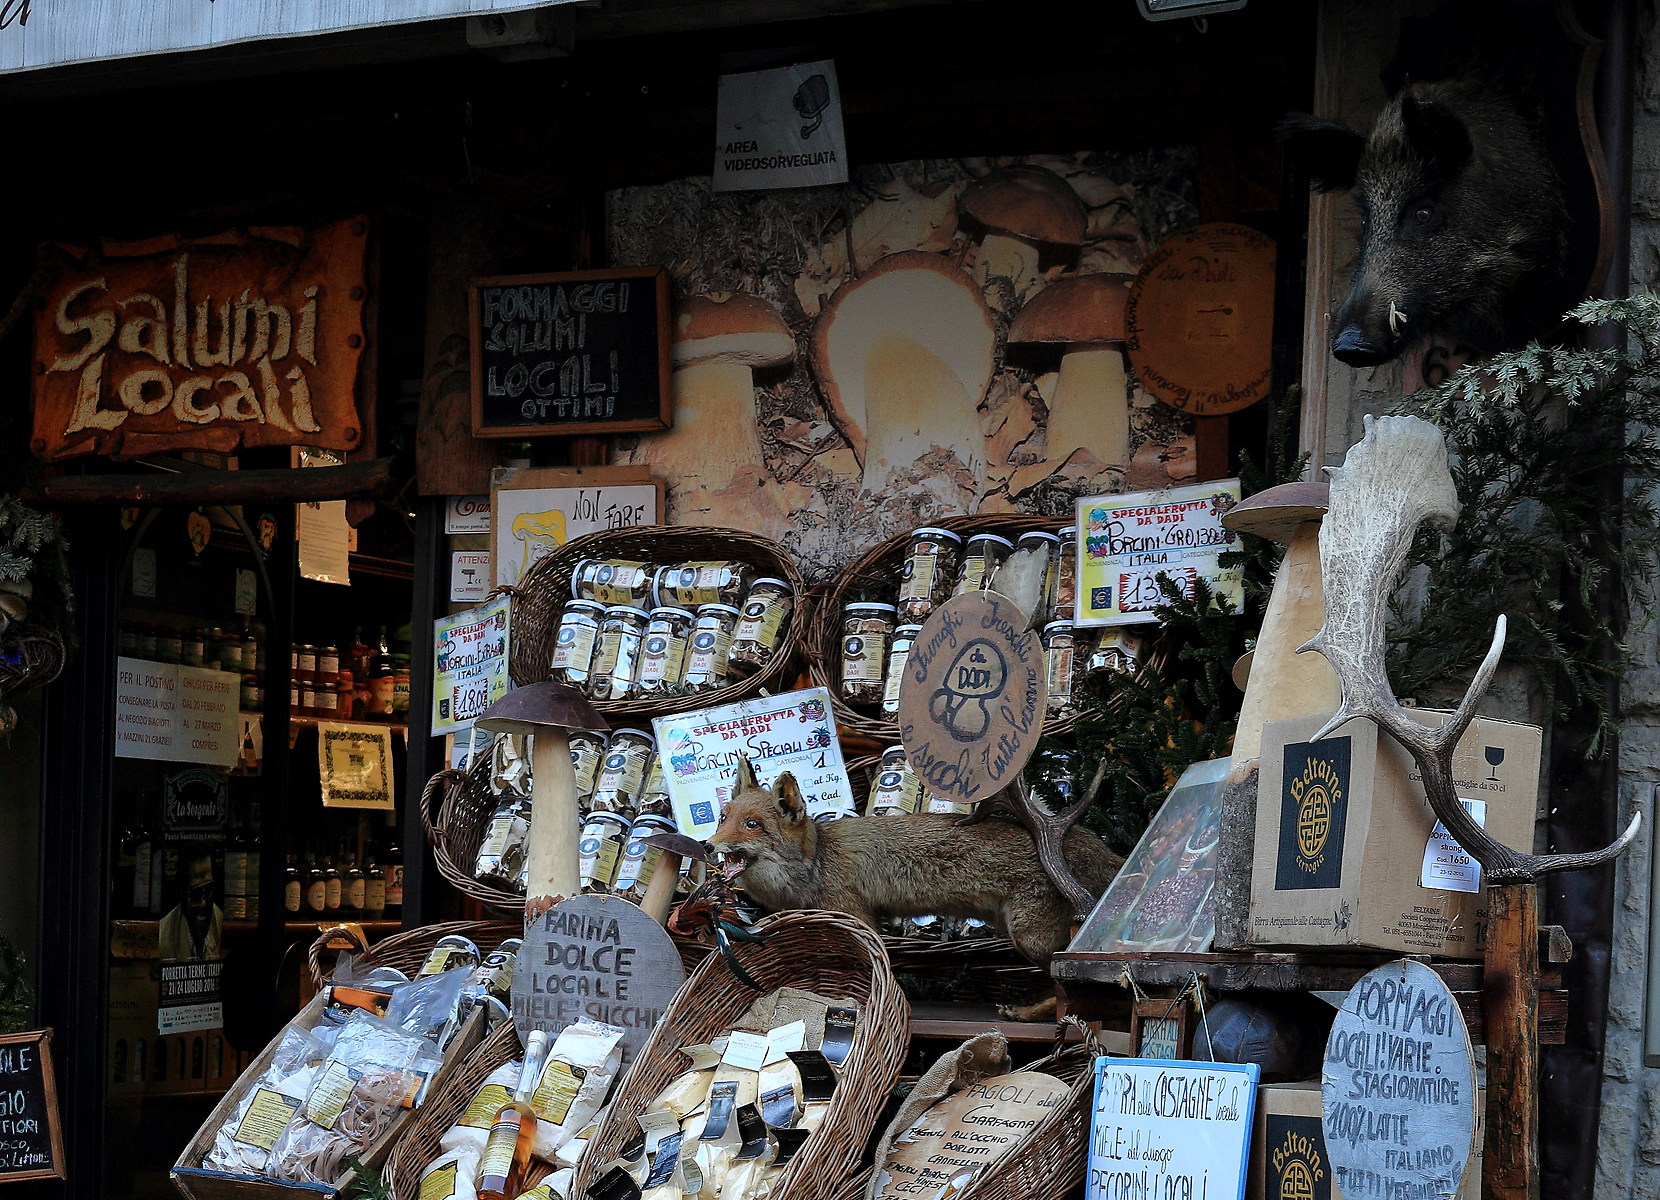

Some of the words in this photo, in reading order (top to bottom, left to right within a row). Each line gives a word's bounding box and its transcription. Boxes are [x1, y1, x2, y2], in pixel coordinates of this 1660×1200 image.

[725, 141, 758, 153] AREA
[725, 151, 836, 171] VIDEOSORVEGLIATA
[46, 253, 319, 374] Salumi
[484, 282, 630, 327] FORMAGGI
[488, 350, 619, 397] LOCALI
[64, 352, 320, 435] Locali
[521, 396, 615, 418] OTTIMI
[572, 490, 602, 522] NON
[1112, 501, 1207, 518] SPECIALFRUTTA
[1137, 517, 1152, 526] DA
[1158, 513, 1185, 525] DADI
[1129, 552, 1168, 566] ITALIA
[908, 610, 964, 683] Funghi
[969, 648, 987, 663] da
[120, 672, 133, 684] PER
[136, 674, 142, 686] IL
[145, 675, 174, 691] POSTINO
[458, 666, 482, 680] ITALIA
[693, 709, 795, 737] SPECIALFRUTTA
[721, 731, 738, 741] DA
[743, 724, 772, 737] DADI
[746, 735, 802, 760] SPECIALI
[1290, 757, 1343, 804] Beltaine
[1441, 844, 1463, 853] strong
[1449, 855, 1470, 865] 1650
[545, 941, 636, 976] DOLCE
[533, 973, 628, 1000] LOCALE
[1356, 976, 1455, 1037] FORMAGGI
[966, 1083, 1034, 1104] FAGIOLI
[1154, 1070, 1215, 1121] CASTAGNE
[951, 1131, 1009, 1144] ALL'OCCHIO
[1367, 1113, 1409, 1147] LATTE
[943, 1142, 991, 1155] BORLOTTI
[1272, 1130, 1324, 1182] Beltaine
[1385, 1144, 1454, 1171] ITALIANO
[887, 1161, 918, 1175] FAGIOLI
[895, 1181, 926, 1195] CECI
